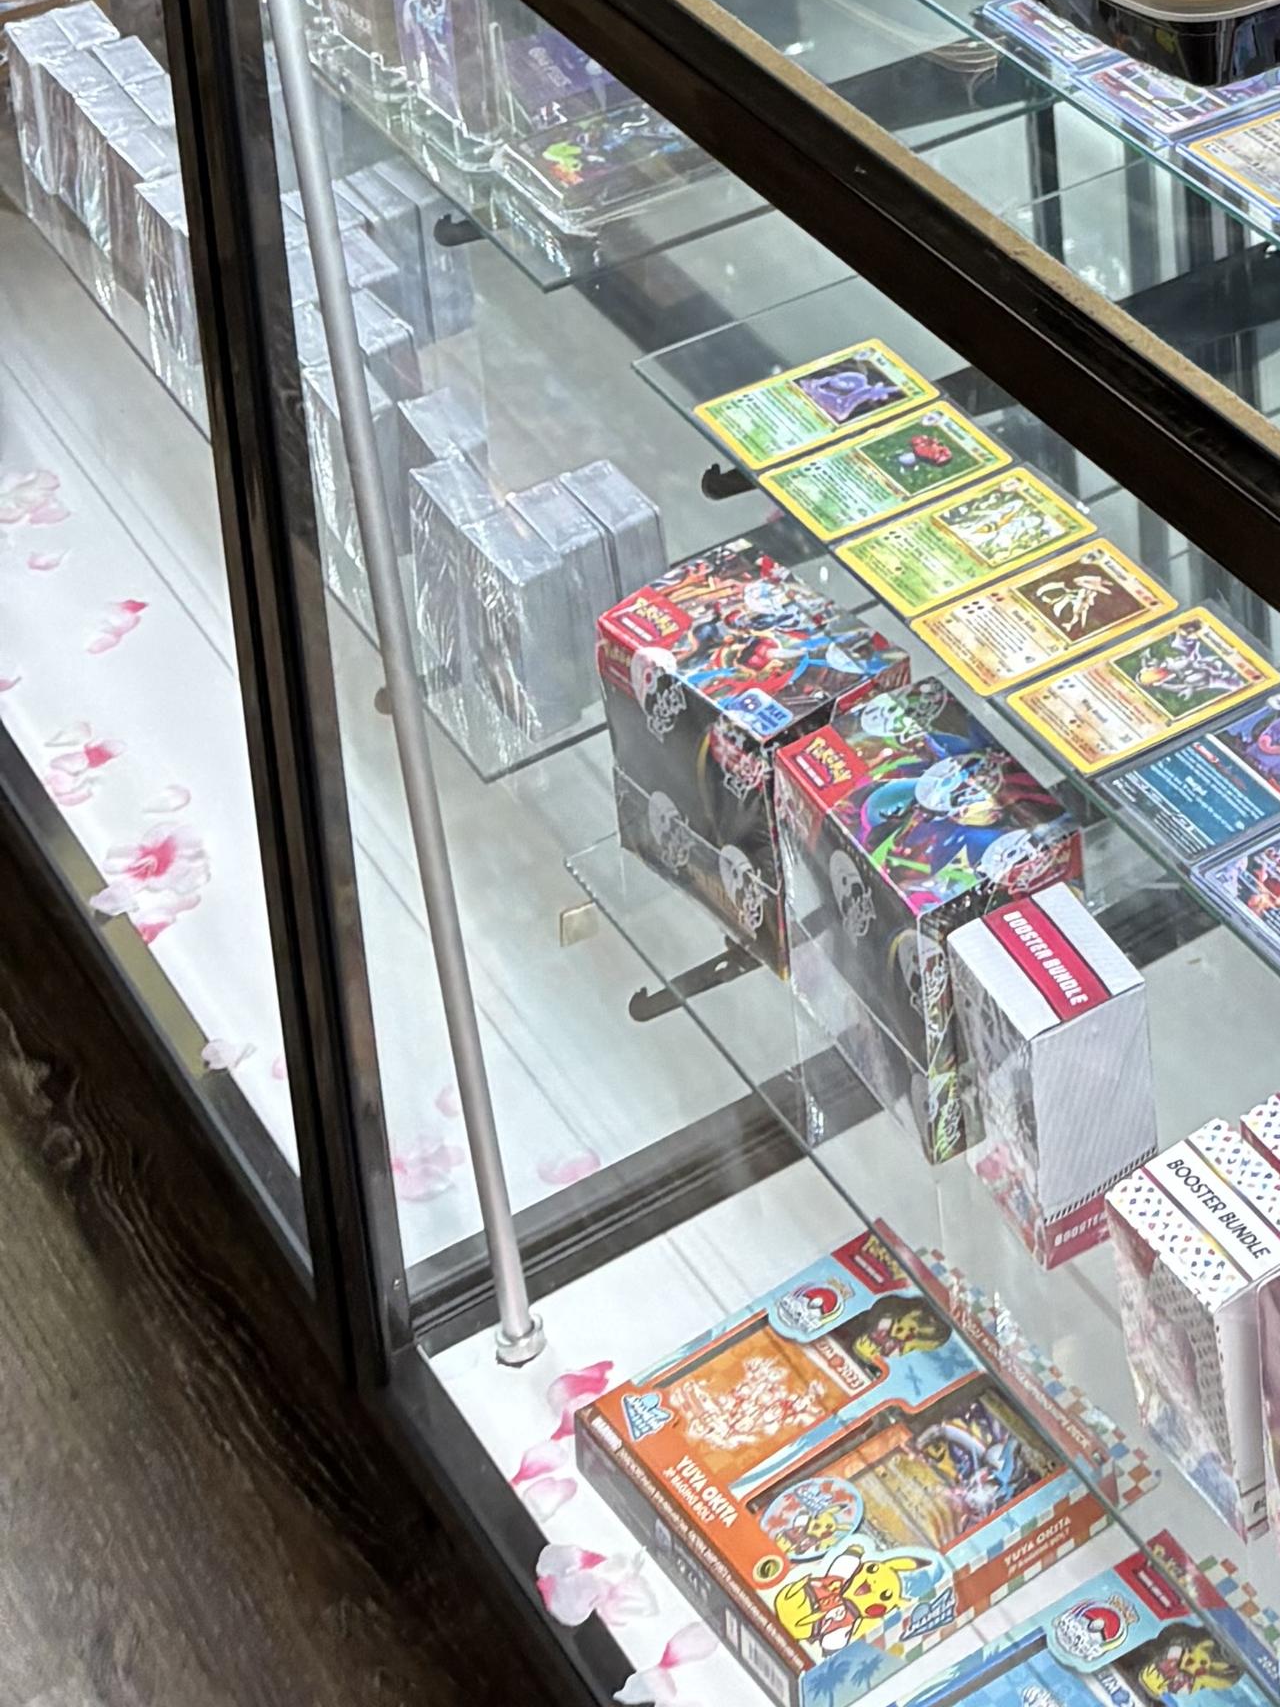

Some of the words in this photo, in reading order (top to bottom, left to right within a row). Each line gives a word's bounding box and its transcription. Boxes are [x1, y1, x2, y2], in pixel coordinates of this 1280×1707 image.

[1002, 907, 1051, 963] BOOSTER
[1041, 954, 1088, 1008] BUNDLE
[1166, 1158, 1229, 1218] BOOSTER
[1217, 1208, 1271, 1260] BUNDLE
[674, 1454, 710, 1491] YUYA
[699, 1483, 741, 1527] OKITA
